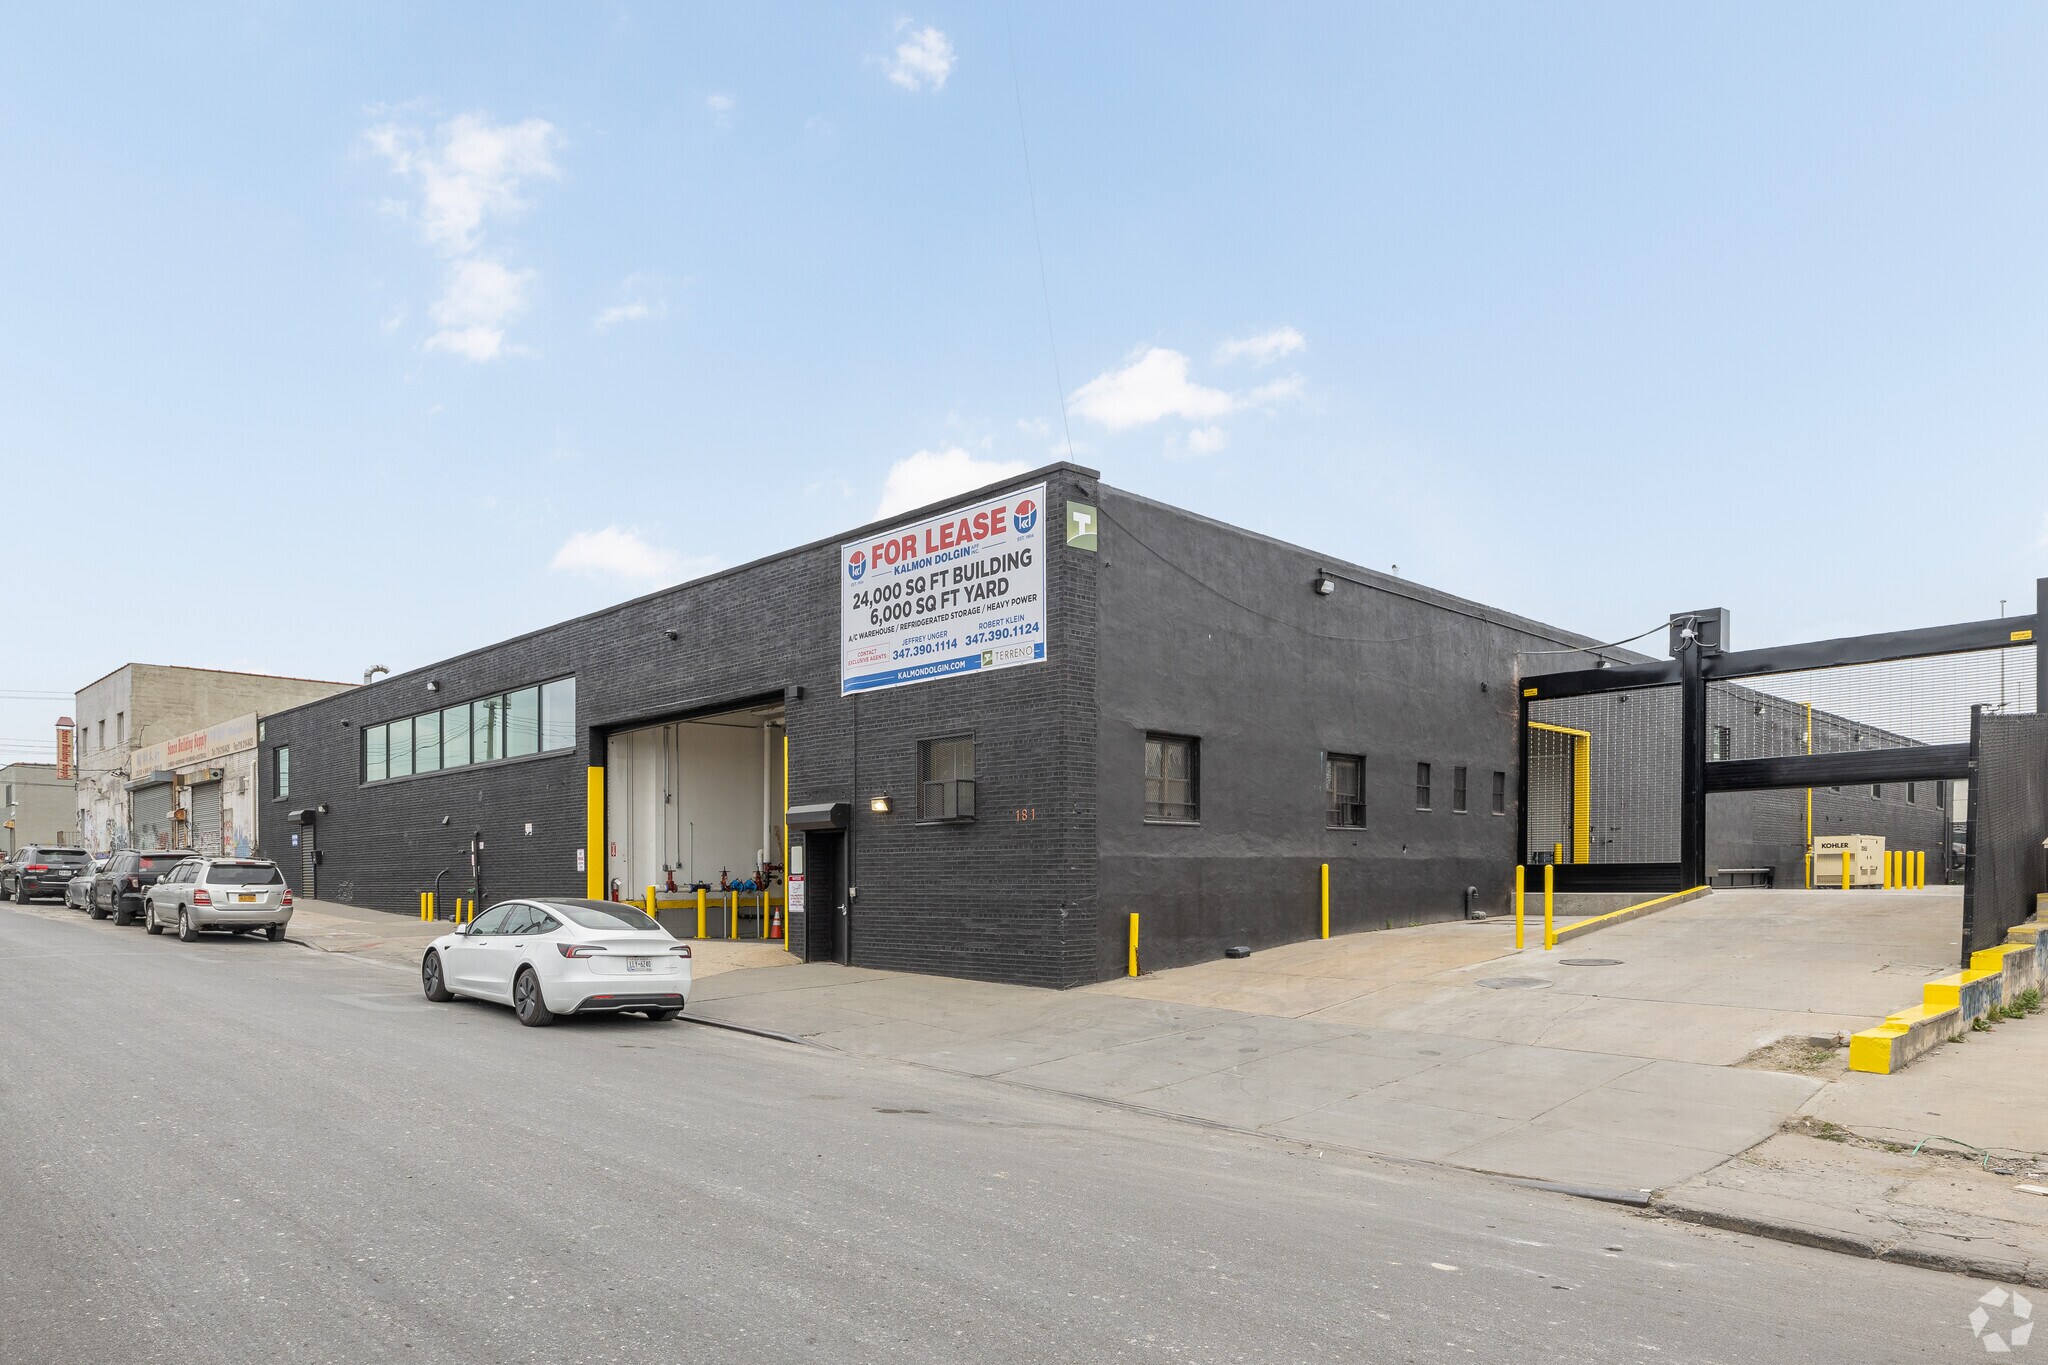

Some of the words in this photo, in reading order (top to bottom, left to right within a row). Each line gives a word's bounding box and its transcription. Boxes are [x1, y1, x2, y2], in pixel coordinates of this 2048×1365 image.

[871, 534, 917, 570] FOR
[925, 505, 1007, 555] LEASE
[894, 557, 932, 576] KALMON
[934, 546, 971, 564] DOLGIN
[853, 582, 902, 610] 24,000
[905, 576, 926, 596] SQ
[930, 569, 949, 590] FT
[953, 548, 1032, 585] BUILDING
[870, 600, 912, 627] 6,000
[916, 594, 937, 615] SQ
[941, 588, 960, 609] FT
[964, 577, 1009, 604] YARD
[848, 633, 859, 643] A/C
[859, 625, 895, 640] WAREHOUSE
[900, 613, 950, 631] REFRIDGERATED
[950, 606, 981, 620] STORAGE
[986, 599, 1010, 612] HEAVY
[1011, 593, 1038, 606] POWER
[978, 618, 1004, 630] ROBERT
[1005, 614, 1025, 625] KLEIN
[902, 633, 927, 646] JEFFREY
[927, 630, 948, 641] UNGER
[965, 621, 1040, 646] 347.390.1124
[848, 657, 870, 667] EXCLUSIVE
[869, 653, 887, 662] AGENTS
[857, 648, 877, 658] CONTACT
[892, 638, 958, 661] 347.390.1114
[995, 645, 1033, 661] TERRENO
[897, 660, 966, 680] KALMONDOLGIN.COM
[1015, 808, 1035, 822] 181
